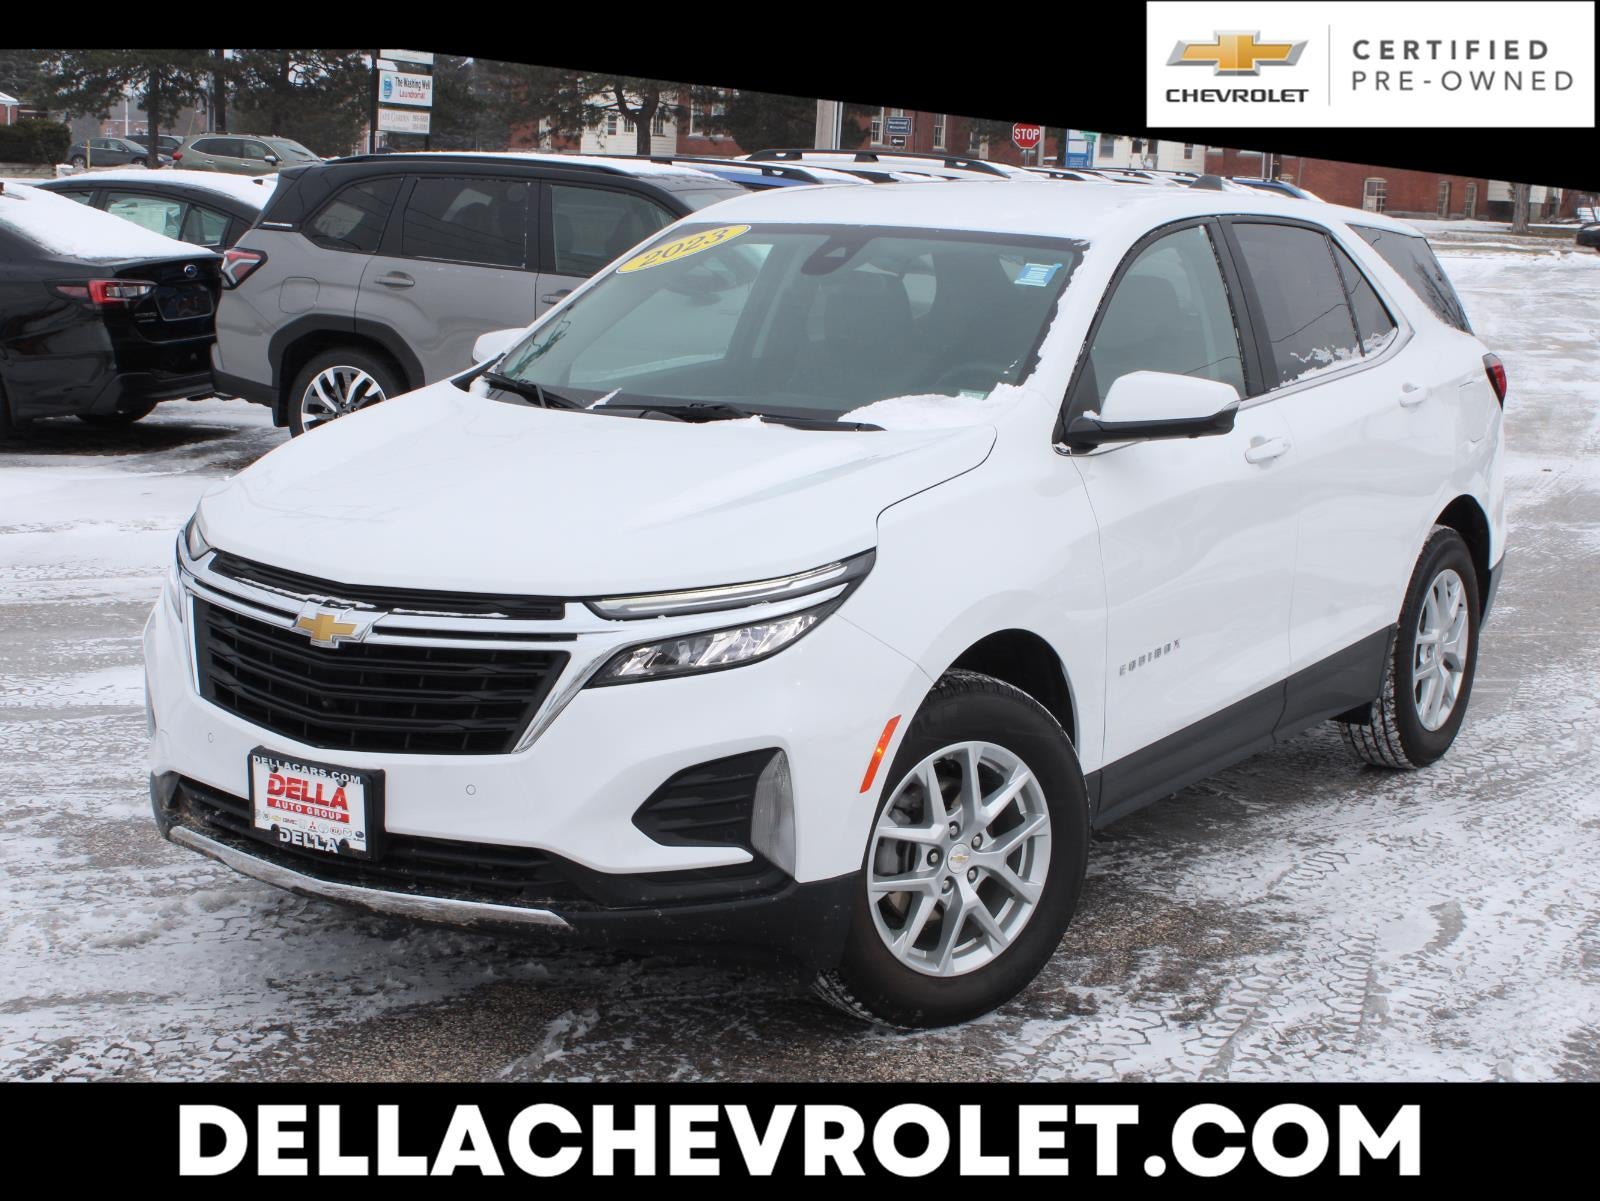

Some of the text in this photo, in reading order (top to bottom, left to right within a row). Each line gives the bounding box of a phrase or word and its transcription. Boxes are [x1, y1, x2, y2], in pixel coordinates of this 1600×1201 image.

[395, 77, 431, 91] The Washing Well
[400, 90, 426, 99] Laundromat
[1014, 128, 1040, 140] STOP
[639, 229, 728, 267] 2023
[1119, 639, 1181, 677] EQUINOX
[253, 755, 361, 785] DELLACARS.COM
[267, 773, 348, 811] DELLA
[275, 801, 341, 821] AUTO GROUP
[279, 826, 339, 854] DELLA
